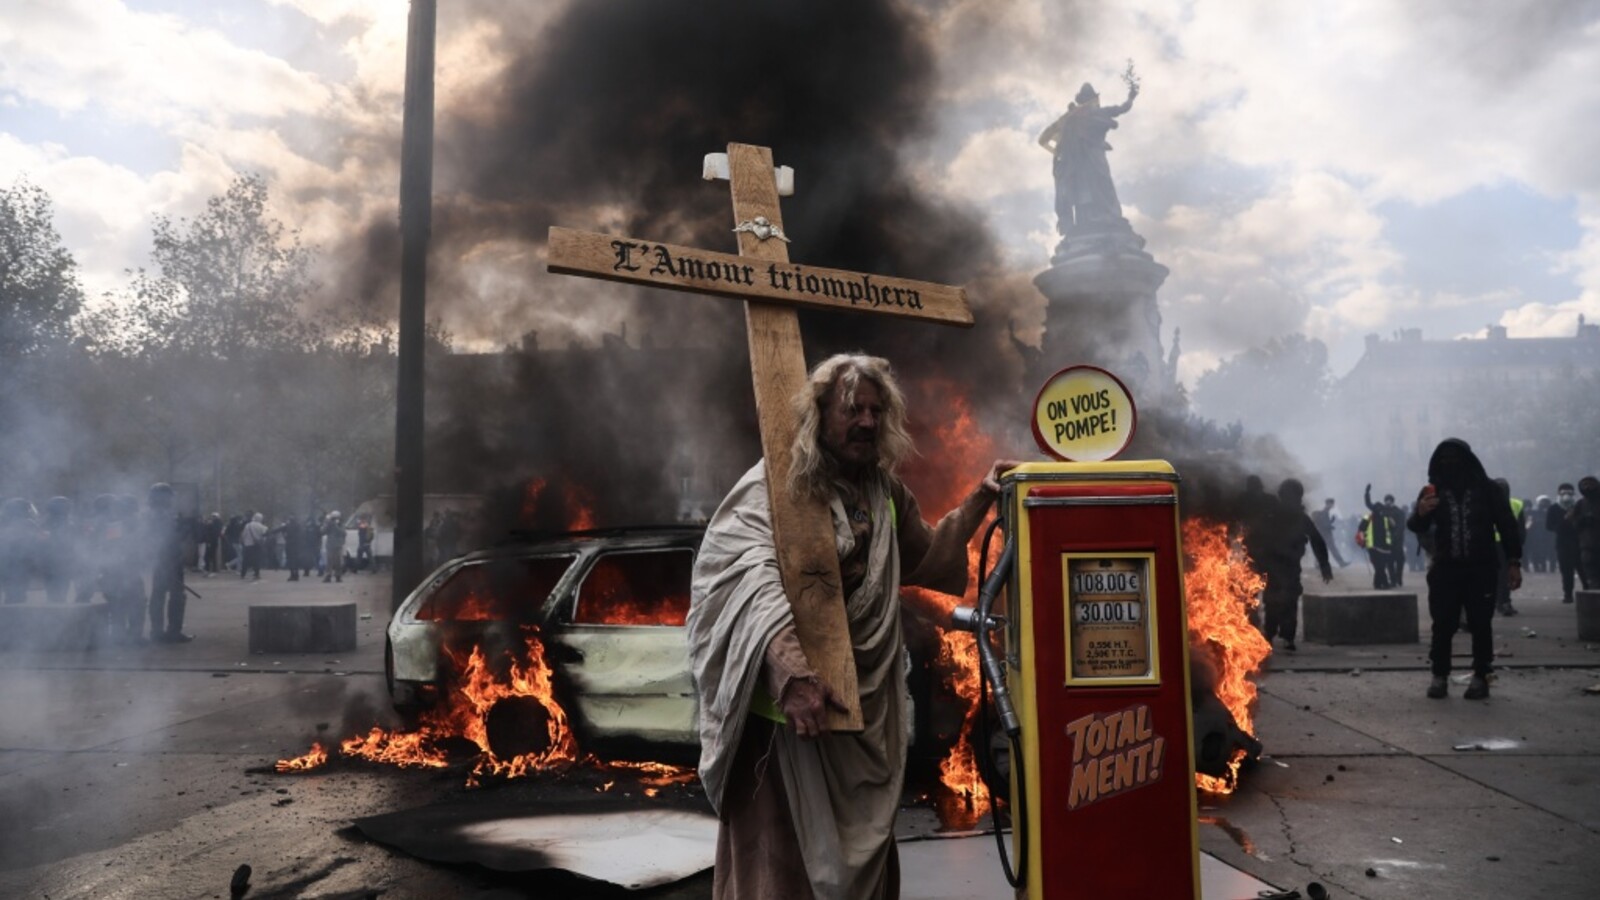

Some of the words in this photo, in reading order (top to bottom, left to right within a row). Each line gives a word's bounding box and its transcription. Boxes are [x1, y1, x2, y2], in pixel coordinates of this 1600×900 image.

[611, 239, 756, 288] L'Amour
[768, 262, 924, 311] triomphera
[1047, 400, 1067, 421] ON
[1071, 389, 1110, 414] VOUS
[1054, 409, 1116, 444] POMPE!
[1066, 705, 1152, 763] TOTAL
[1068, 737, 1165, 809] MENT!
